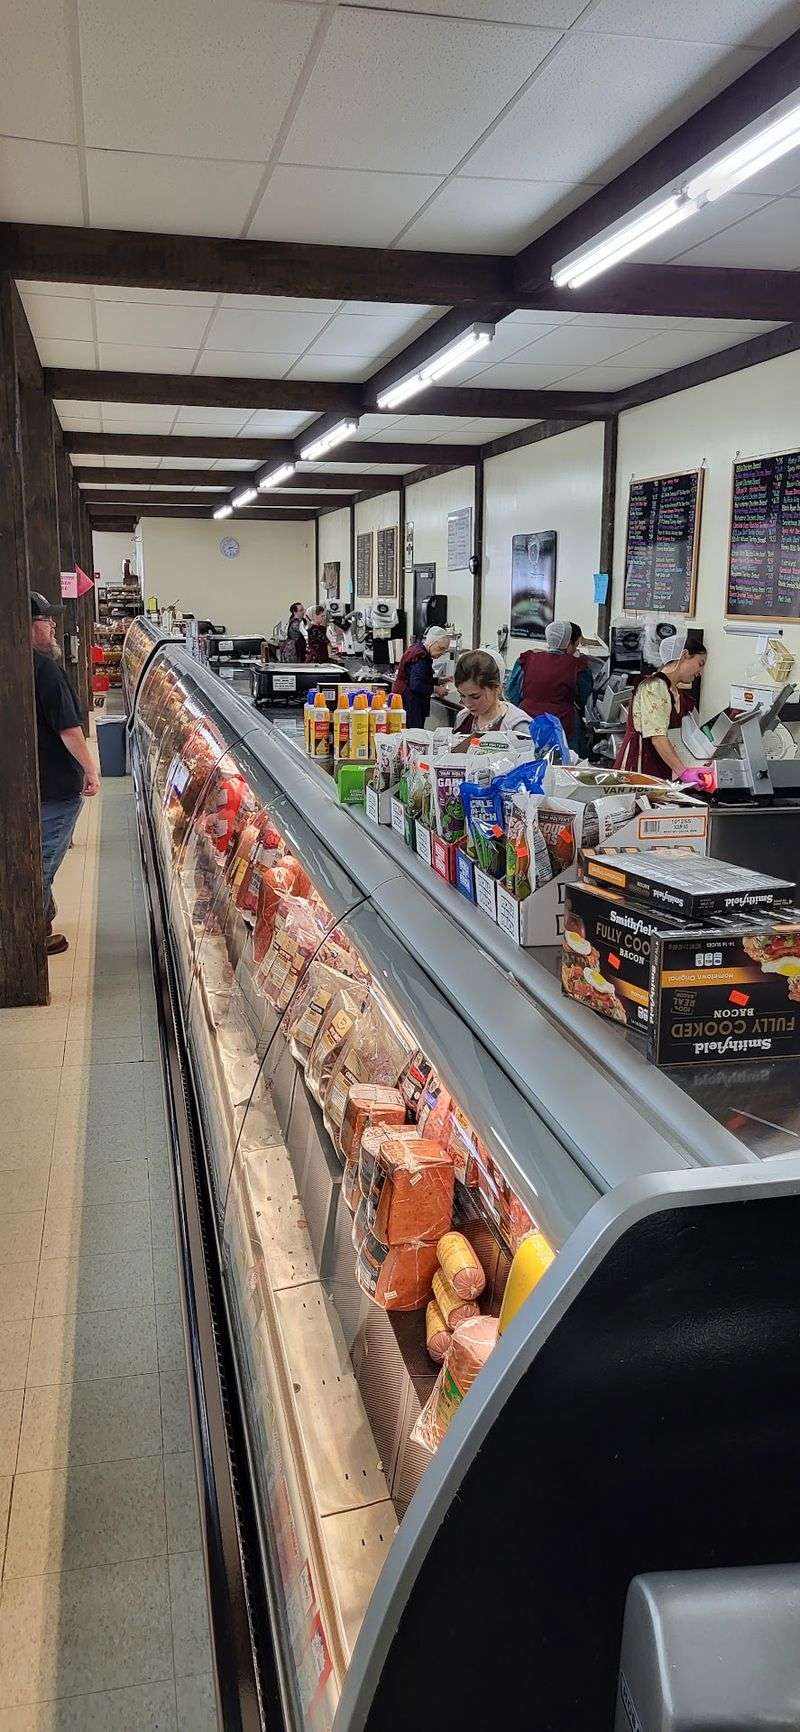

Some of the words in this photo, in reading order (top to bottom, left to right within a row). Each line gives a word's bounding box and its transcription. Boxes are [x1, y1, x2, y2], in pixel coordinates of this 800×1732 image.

[603, 786, 625, 794] VAN
[652, 889, 684, 907] Smithfield
[724, 893, 774, 907] Smithfield
[595, 922, 622, 944] FULLY
[619, 948, 645, 965] BACON
[667, 974, 696, 982] Original
[673, 996, 696, 1007] REAL
[713, 1007, 755, 1019] BACON
[671, 1019, 746, 1038] COOKED
[751, 1017, 795, 1034] FULLY
[693, 1036, 772, 1055] Smithfield
